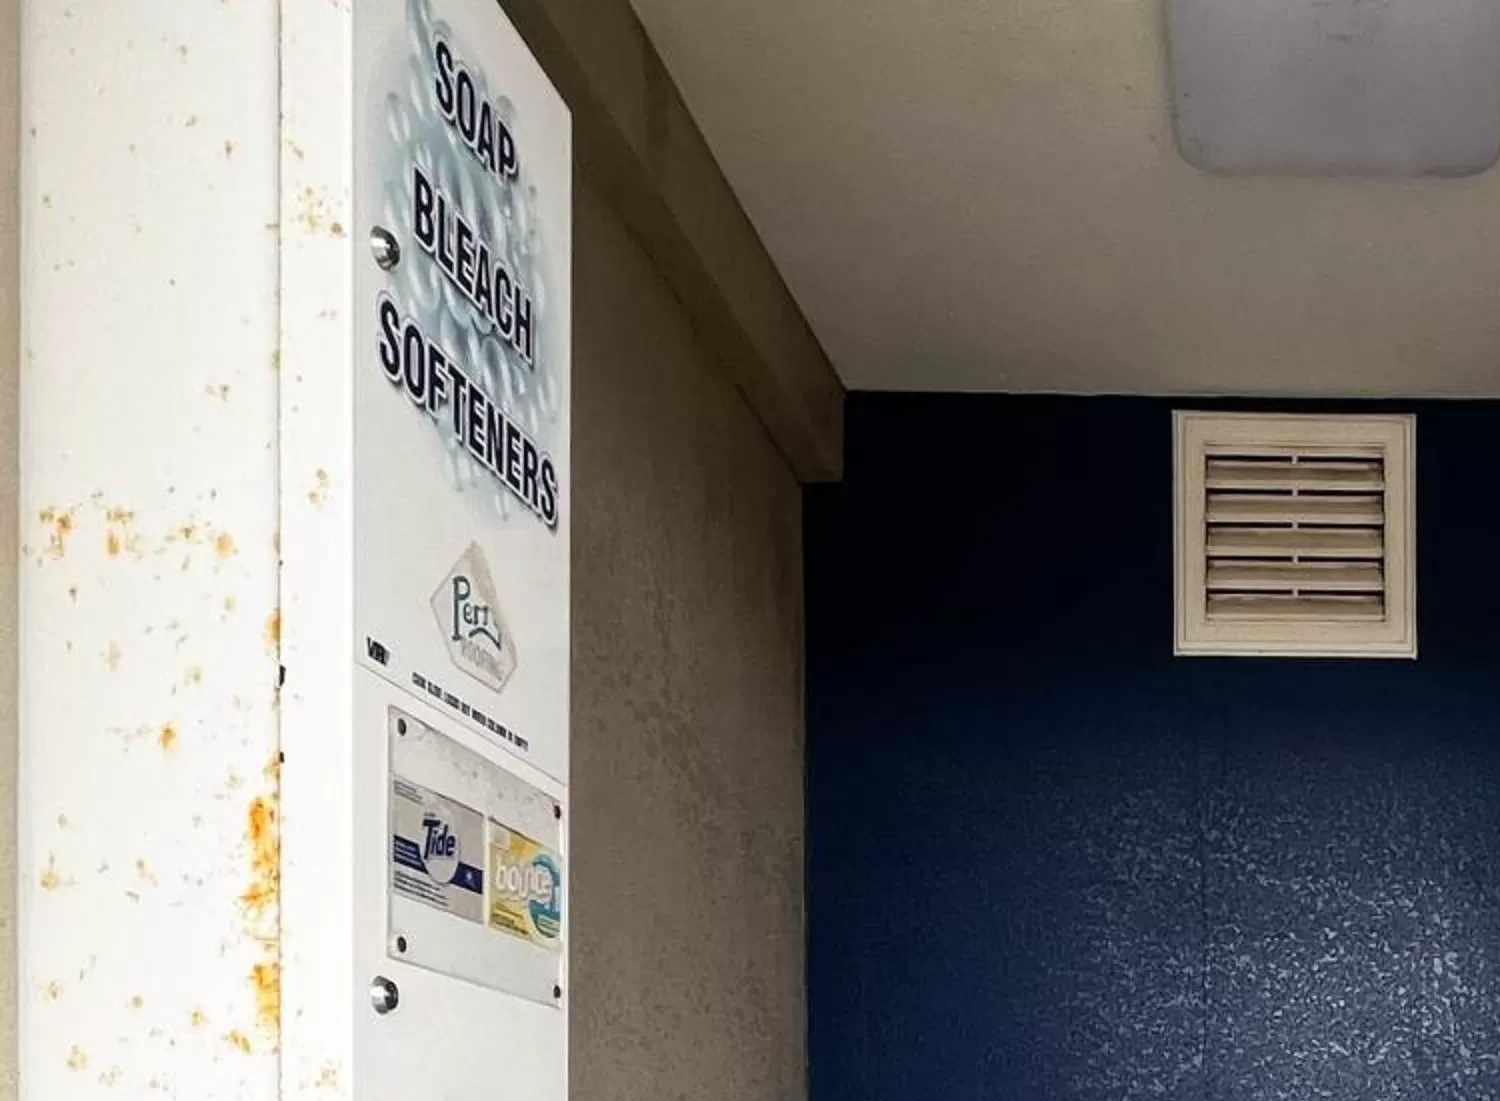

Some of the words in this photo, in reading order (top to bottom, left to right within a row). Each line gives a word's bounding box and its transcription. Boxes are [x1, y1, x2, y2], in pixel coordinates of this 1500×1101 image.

[435, 40, 518, 181] SOAP
[413, 166, 533, 362] BLEACH
[379, 296, 558, 525] SOFTENERS
[422, 819, 456, 860] Tide
